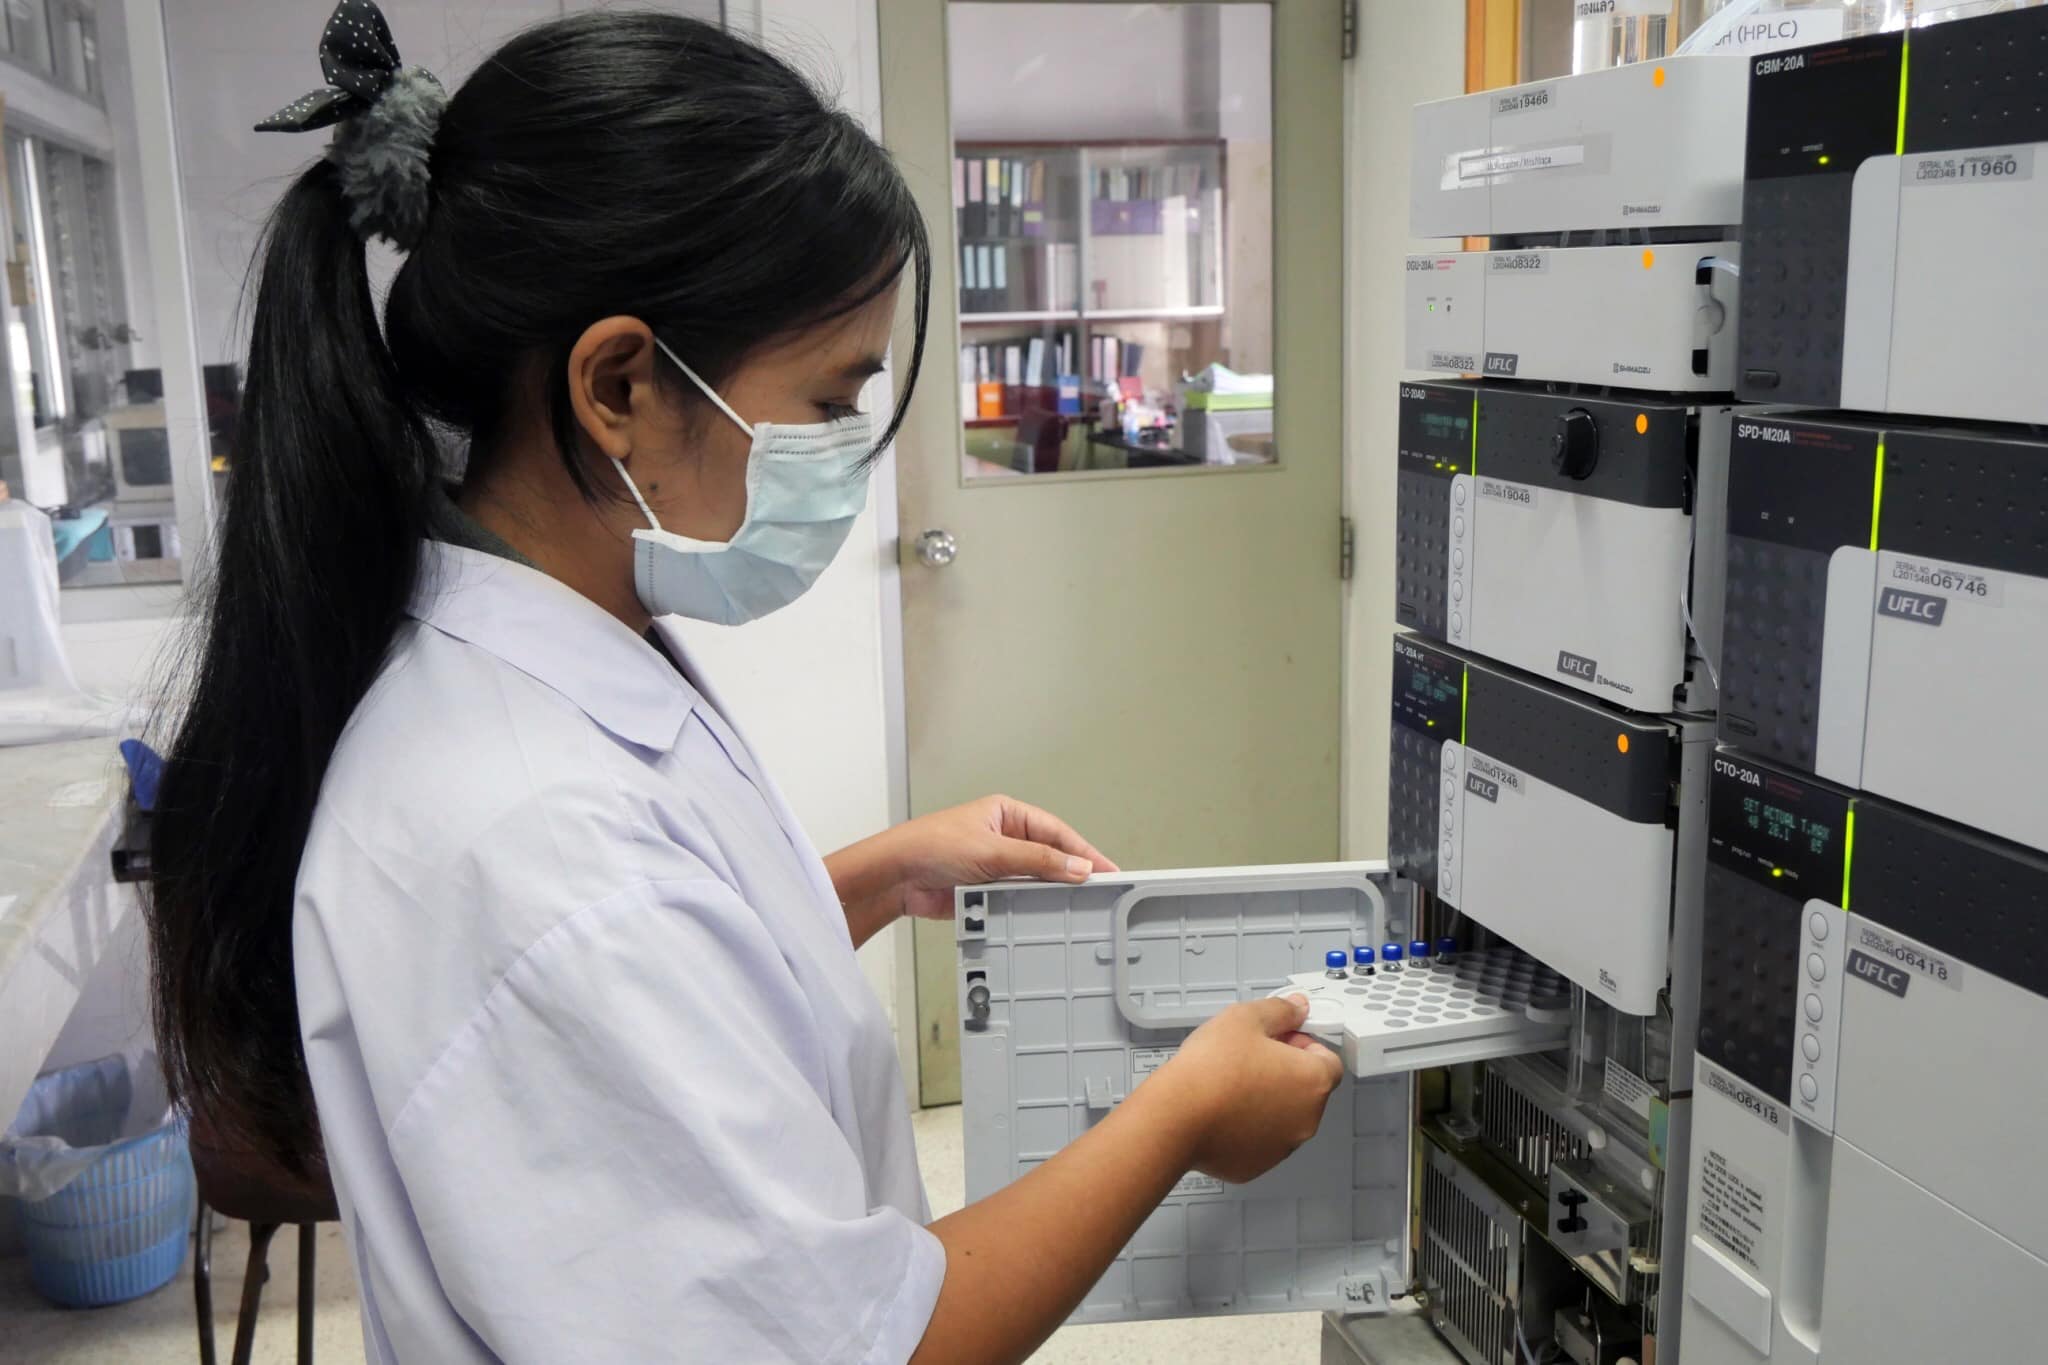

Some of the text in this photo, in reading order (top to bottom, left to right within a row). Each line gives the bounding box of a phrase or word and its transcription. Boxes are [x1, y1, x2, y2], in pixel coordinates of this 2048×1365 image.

[1738, 20, 1799, 43] (HPLC)
[1756, 54, 1805, 76] CBM-20A
[1959, 160, 2017, 177] 11960
[1488, 357, 1514, 371] UFLC
[1738, 424, 1791, 444] SPD-M20A
[1930, 573, 1987, 597] 06746
[1887, 594, 1937, 619] UFLC
[1562, 655, 1593, 676] UFLC
[1714, 759, 1760, 787] CTO-20A
[1470, 777, 1494, 798] UFLC
[1855, 957, 1901, 990] UFLC
[1895, 947, 1948, 981] 06418
